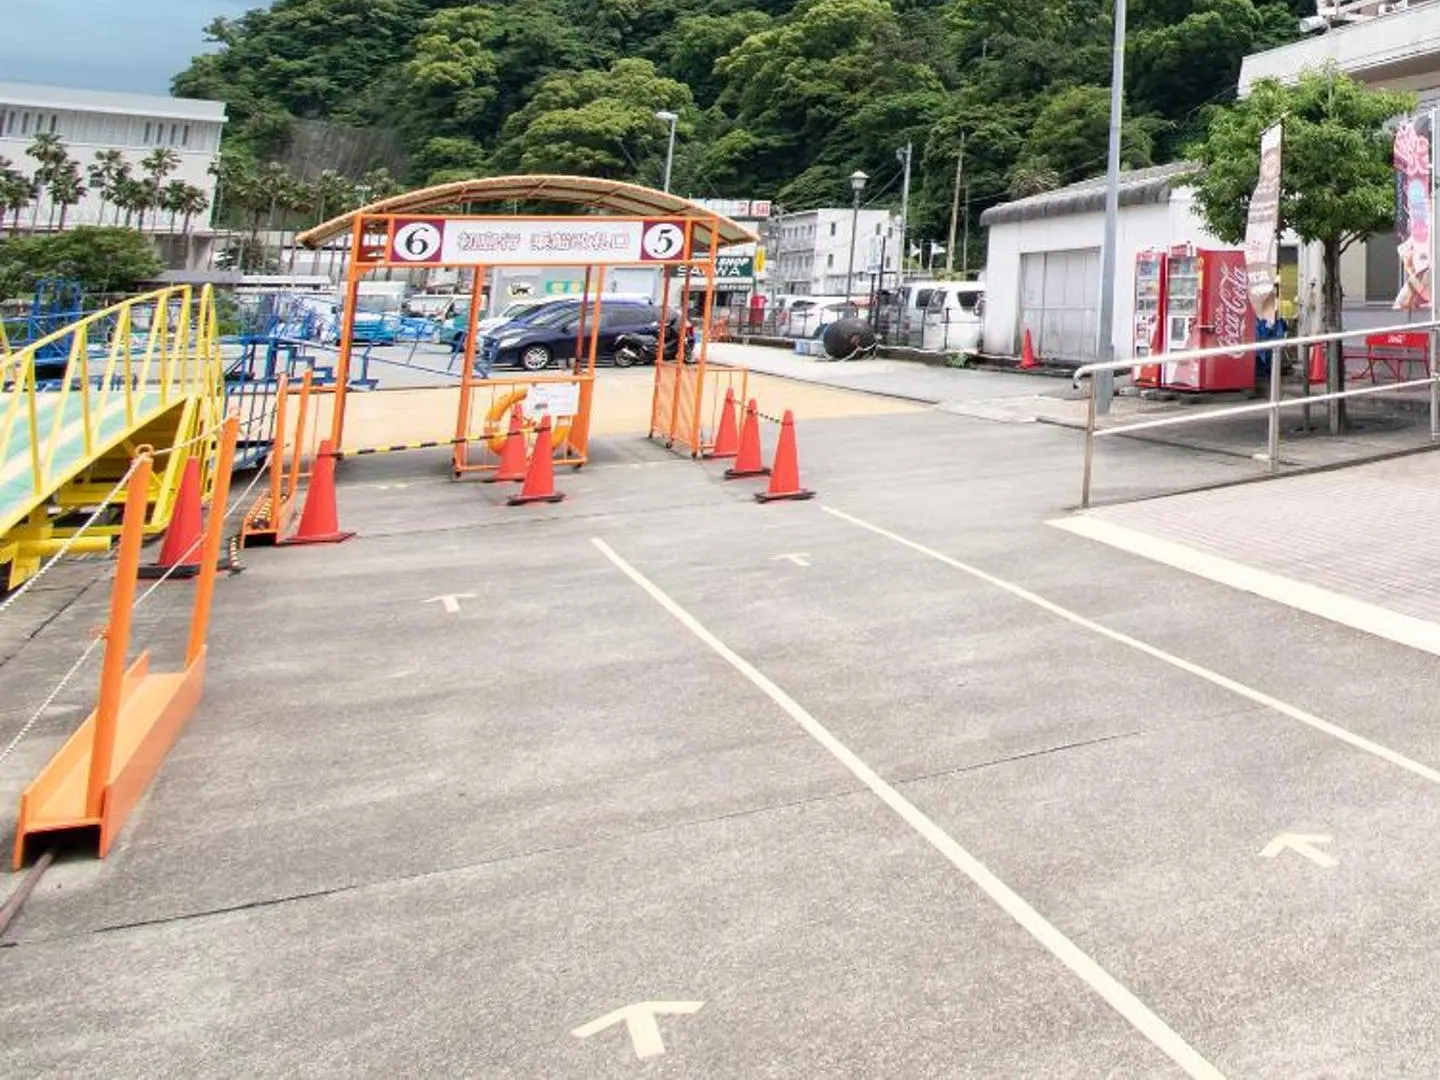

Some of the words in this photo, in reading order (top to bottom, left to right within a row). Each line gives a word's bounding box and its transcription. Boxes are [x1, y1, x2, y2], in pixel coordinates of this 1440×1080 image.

[404, 226, 430, 255] 6
[653, 228, 674, 255] 5
[676, 265, 741, 276] SAWA
